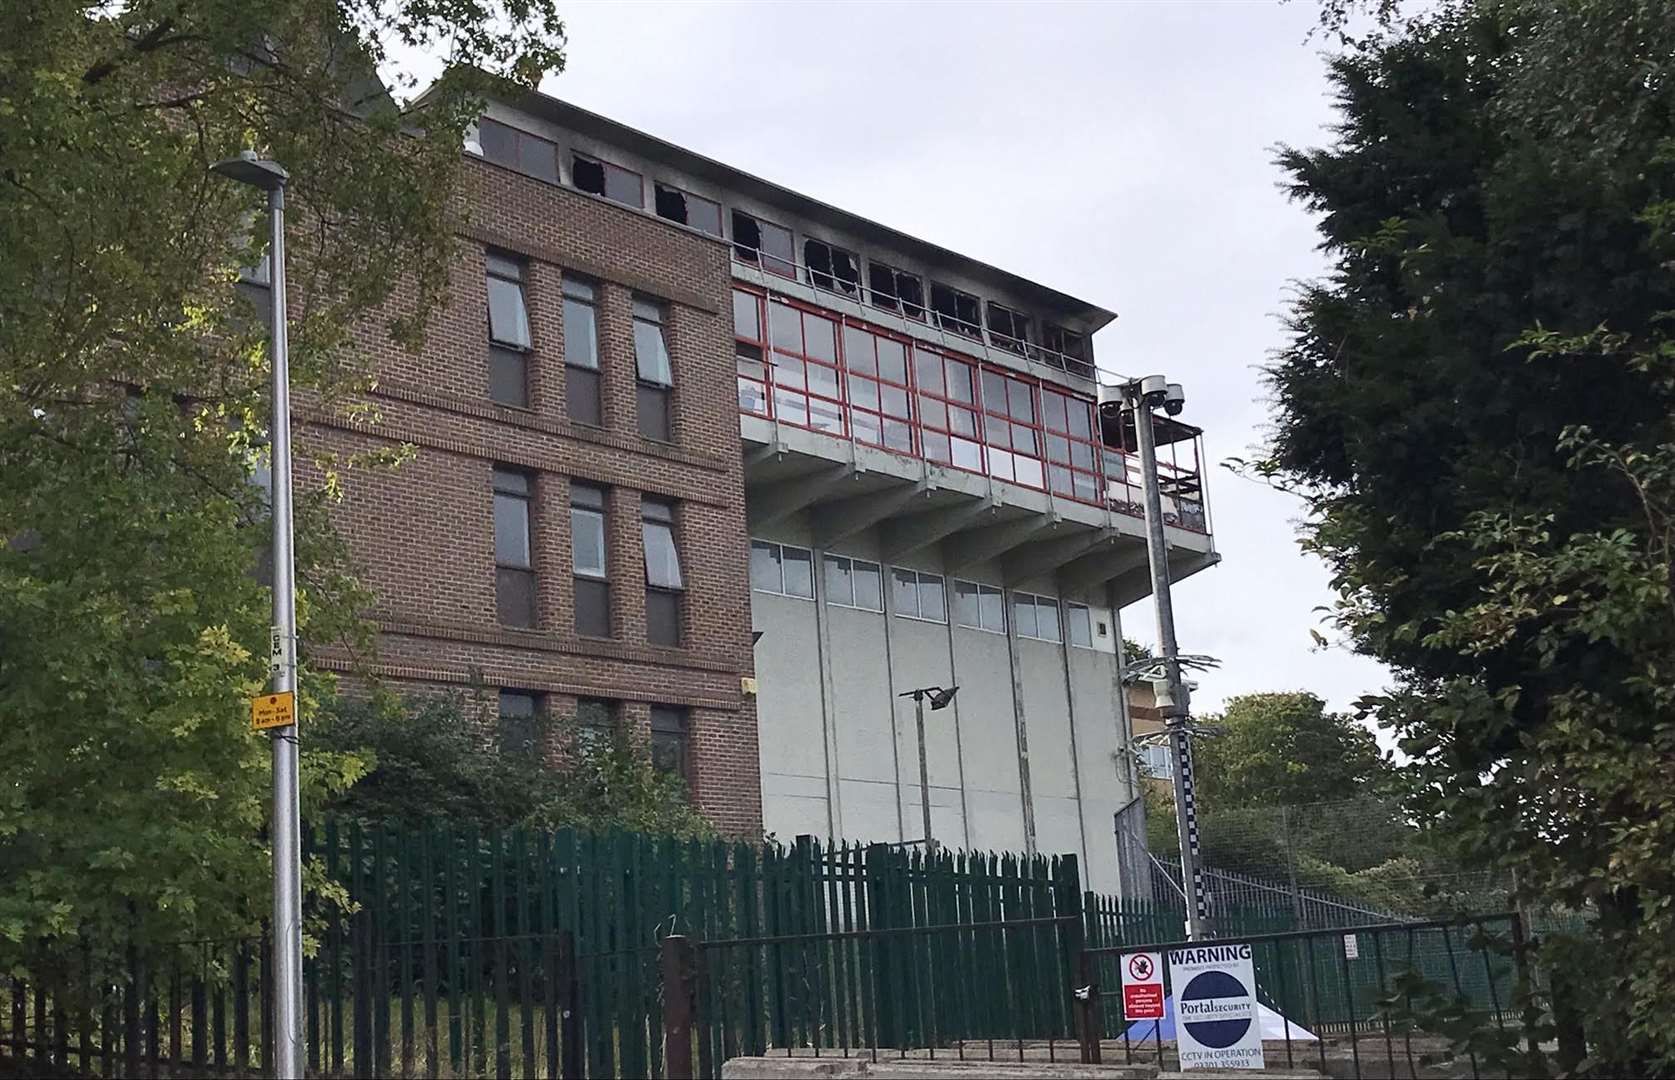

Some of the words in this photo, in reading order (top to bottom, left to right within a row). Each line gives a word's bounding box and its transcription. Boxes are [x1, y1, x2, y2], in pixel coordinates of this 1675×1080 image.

[1169, 945, 1251, 965] WARNING
[1181, 1052, 1203, 1061] CCTV
[1204, 1051, 1213, 1059] IN
[1214, 1048, 1261, 1059] OPERATION
